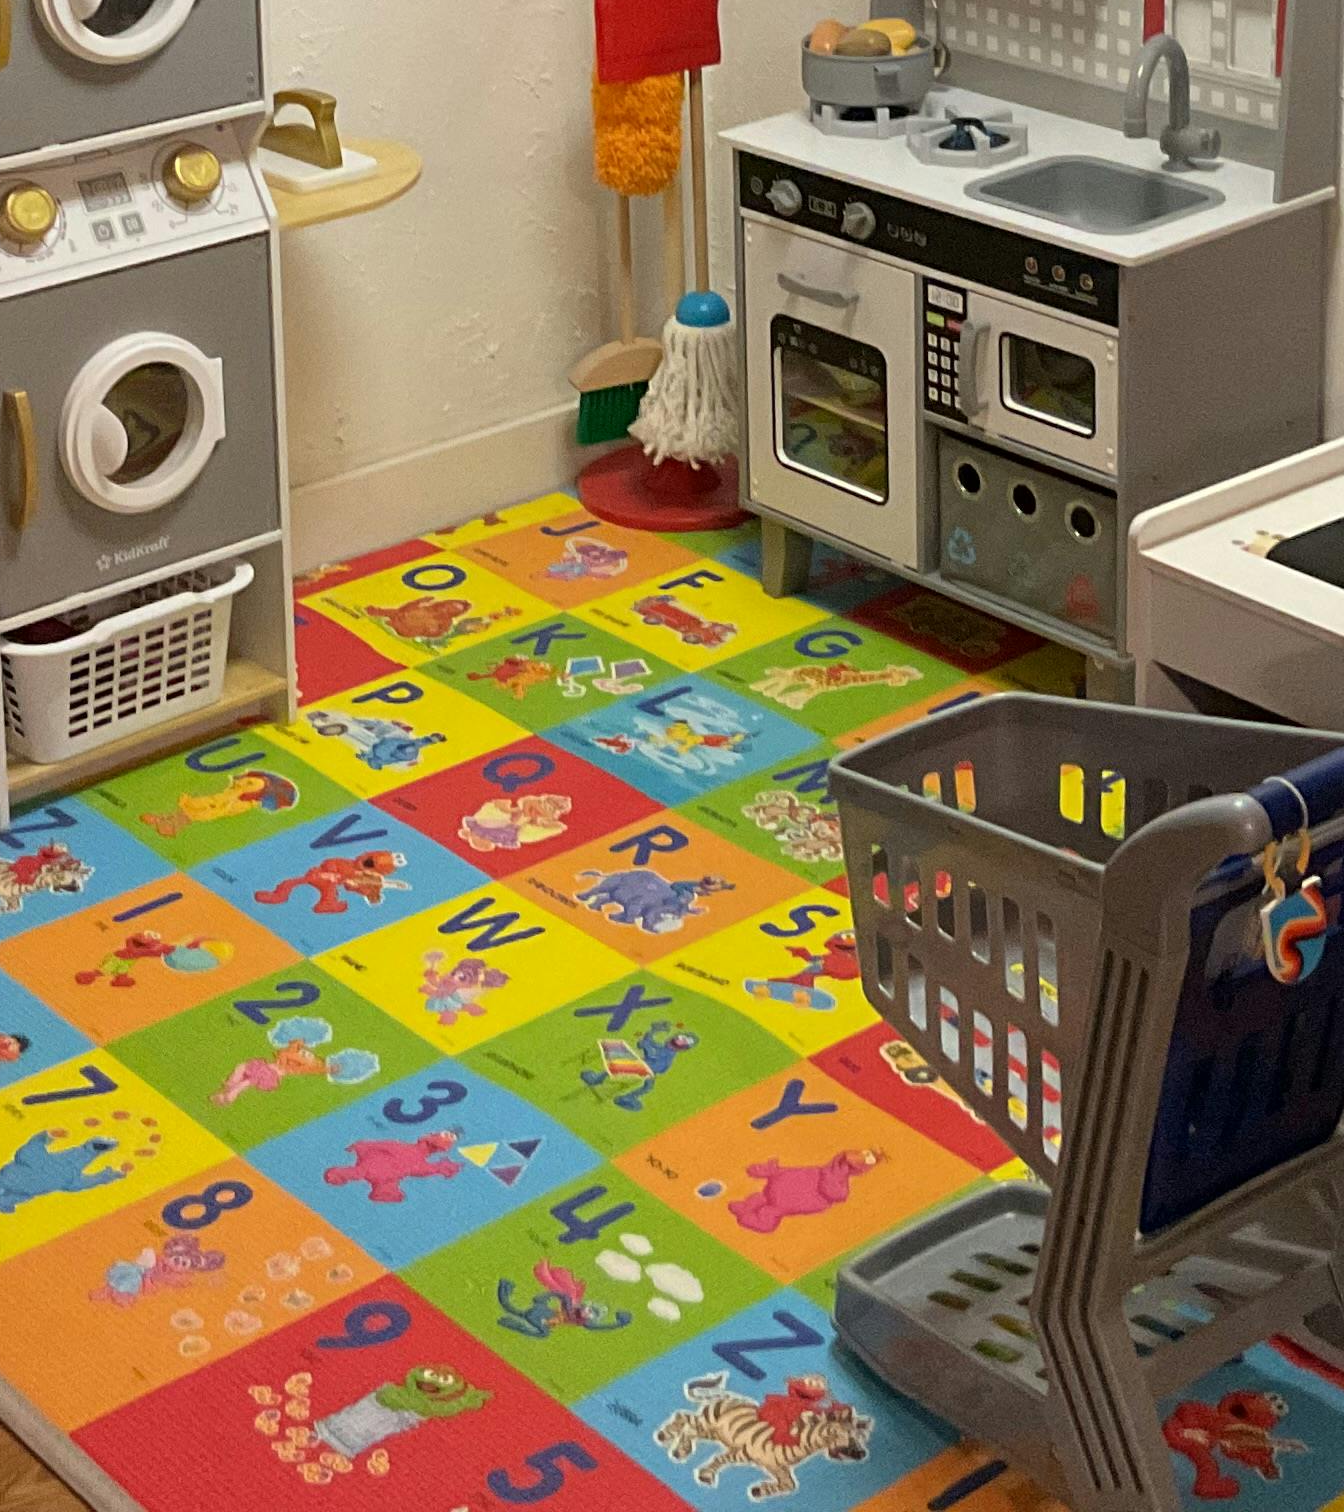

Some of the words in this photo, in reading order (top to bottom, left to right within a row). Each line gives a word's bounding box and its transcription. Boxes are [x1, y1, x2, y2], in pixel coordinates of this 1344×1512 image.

[539, 520, 600, 536] J
[113, 534, 171, 566] KidKraft
[402, 564, 466, 591] O
[660, 569, 726, 591] F
[511, 623, 587, 655] K
[794, 630, 863, 658] G
[351, 680, 423, 710] P
[636, 686, 692, 717] L
[185, 739, 266, 772] U
[482, 752, 556, 793] Q
[309, 813, 388, 849] V
[609, 825, 689, 866] R
[437, 897, 546, 952] W
[760, 904, 841, 938] S
[233, 981, 321, 1025] 2
[573, 985, 673, 1032] X
[22, 1065, 118, 1104] 7
[383, 1080, 468, 1124] 3
[750, 1079, 839, 1130] Y
[162, 1180, 253, 1229] 8
[550, 1185, 636, 1245] 4
[315, 1302, 412, 1352] 9
[712, 1310, 826, 1381] Z
[486, 1441, 599, 1503] 5
